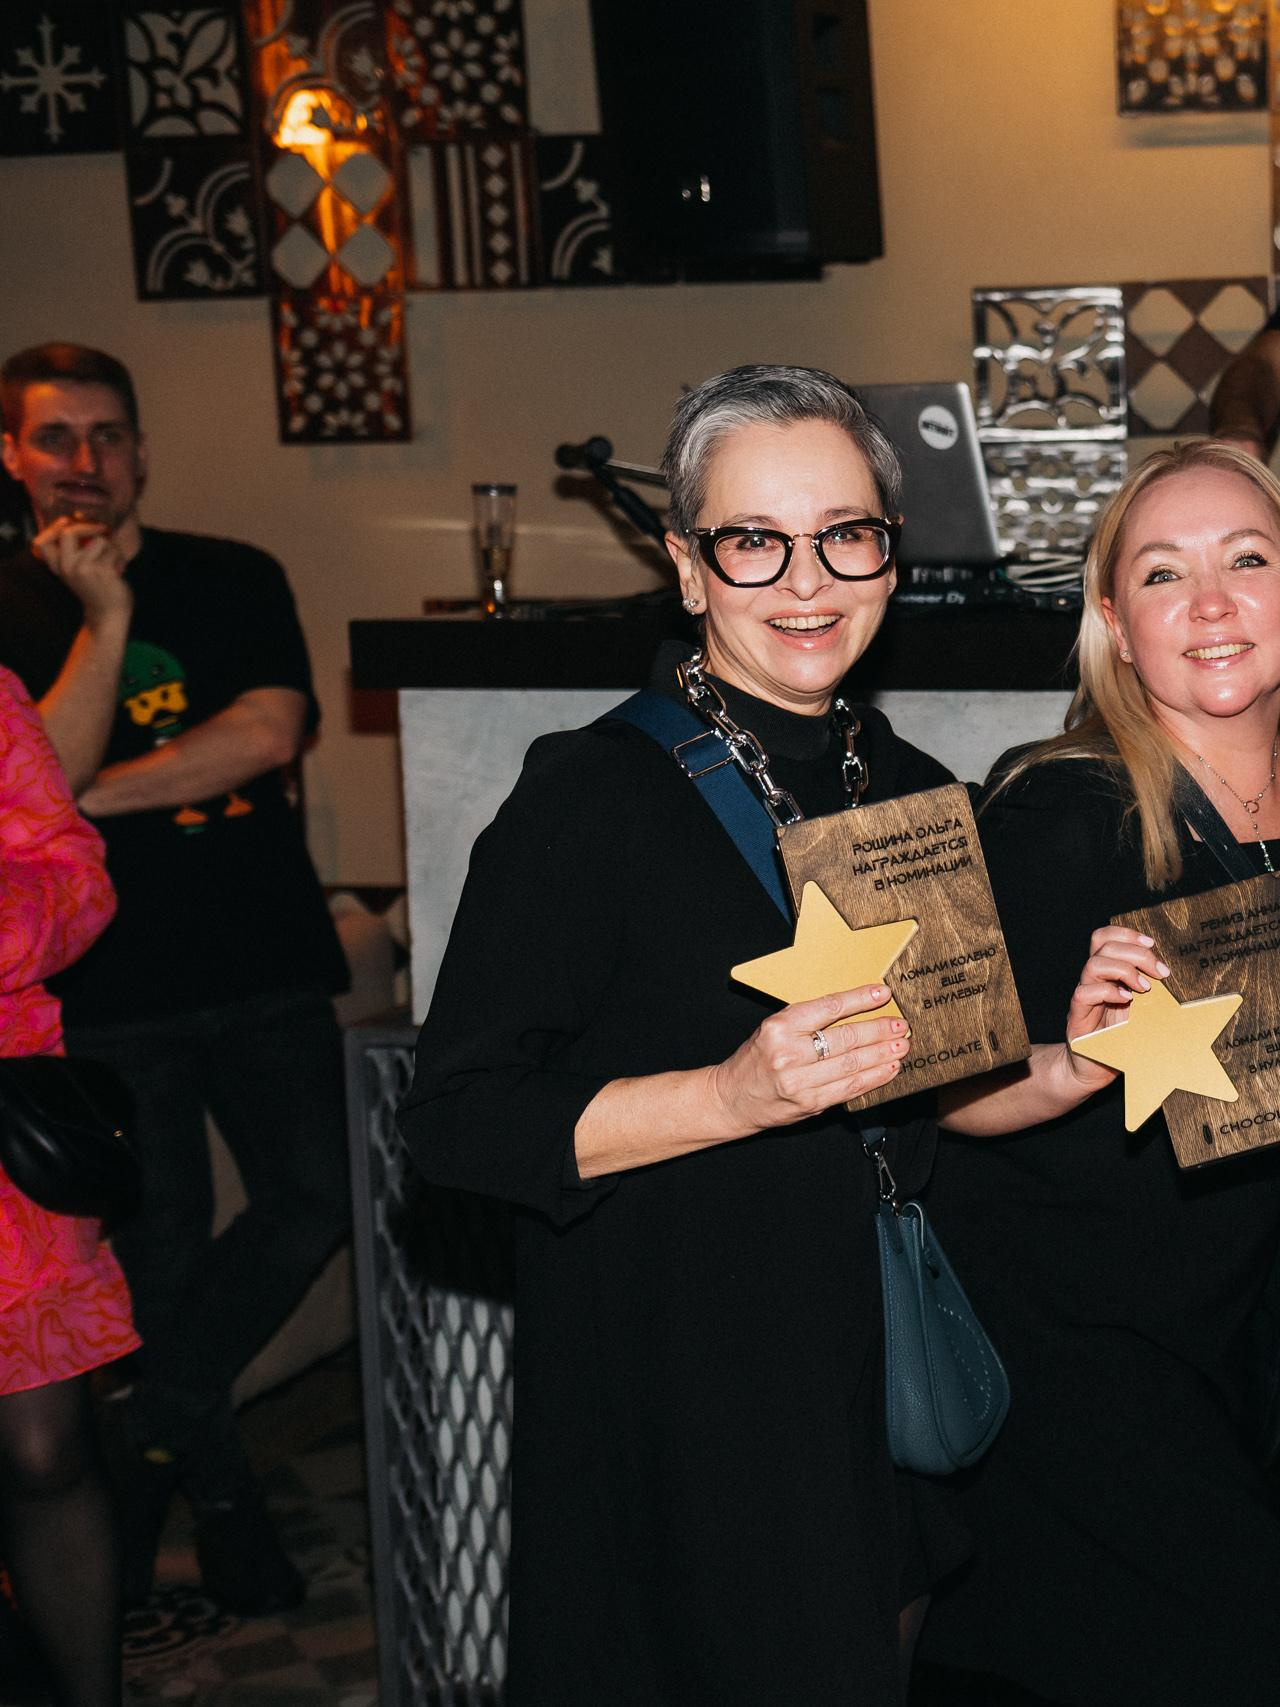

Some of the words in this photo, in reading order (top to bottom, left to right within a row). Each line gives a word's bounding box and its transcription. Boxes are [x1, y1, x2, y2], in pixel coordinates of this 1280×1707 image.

[852, 830, 913, 855] РОЩИНА
[916, 819, 963, 839] ОЛЬГА
[853, 836, 968, 876] НАГРАЖДАЕТСЯ
[875, 879, 885, 891] В
[888, 855, 972, 887] НОМИНАЦИИ
[1200, 912, 1244, 930] РЕМИЗ
[899, 961, 949, 983] ЛОМАЛИ
[950, 947, 996, 969] КОЛЕНО
[1199, 958, 1209, 969] В
[941, 972, 965, 985] ЕЩЕ
[924, 999, 932, 1009] В
[934, 984, 988, 1007] НУЛЕВЫХ
[1225, 1030, 1272, 1050] ЛОМАЛИ
[1249, 1064, 1257, 1073] В
